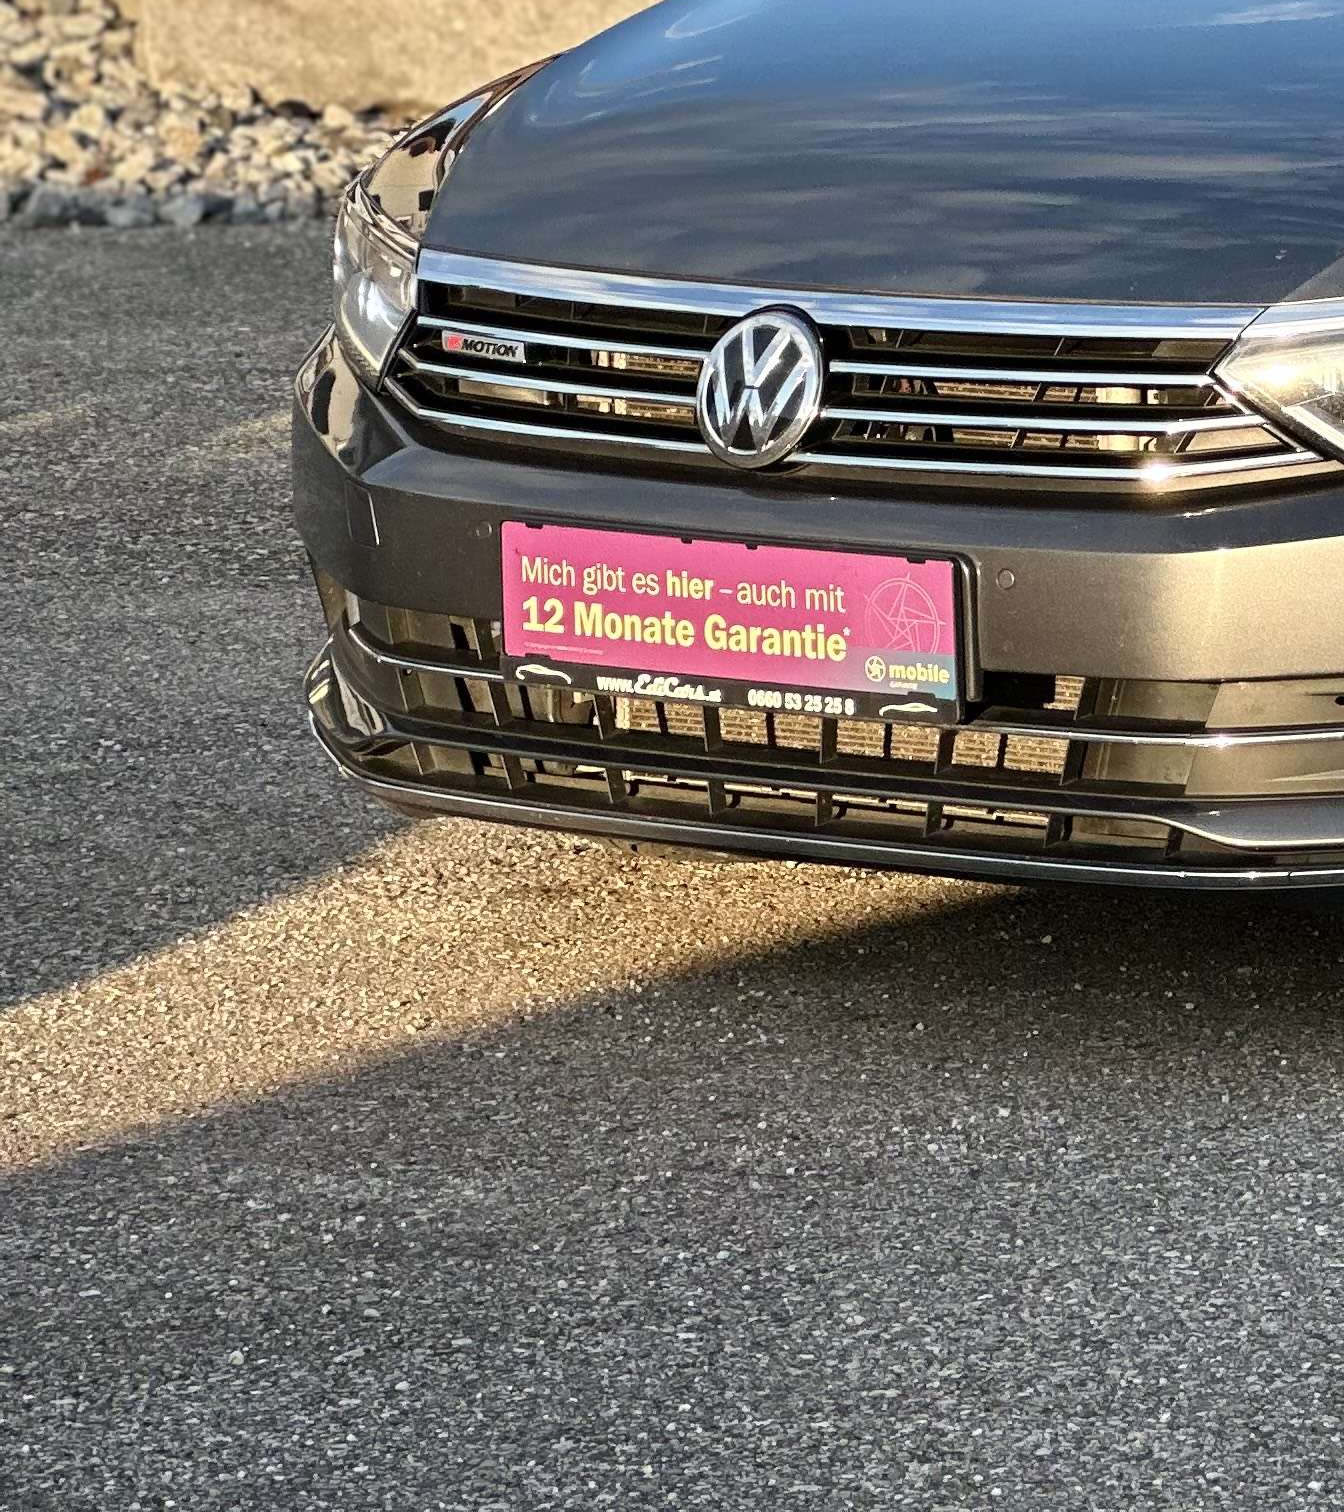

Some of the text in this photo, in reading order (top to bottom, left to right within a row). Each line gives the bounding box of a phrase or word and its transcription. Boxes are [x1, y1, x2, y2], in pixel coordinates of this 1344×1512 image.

[521, 555, 576, 587] Mich
[583, 563, 626, 595] gibt
[632, 572, 660, 596] es
[666, 569, 714, 600] hier
[736, 579, 796, 609] auch
[805, 584, 847, 614] mit
[522, 595, 565, 634] 12
[574, 600, 696, 648] Monate
[888, 662, 951, 684] mobile
[748, 688, 783, 709] 0660
[784, 692, 802, 710] 53
[803, 693, 823, 713] 25
[824, 696, 843, 715] 25
[844, 697, 855, 716] 8
